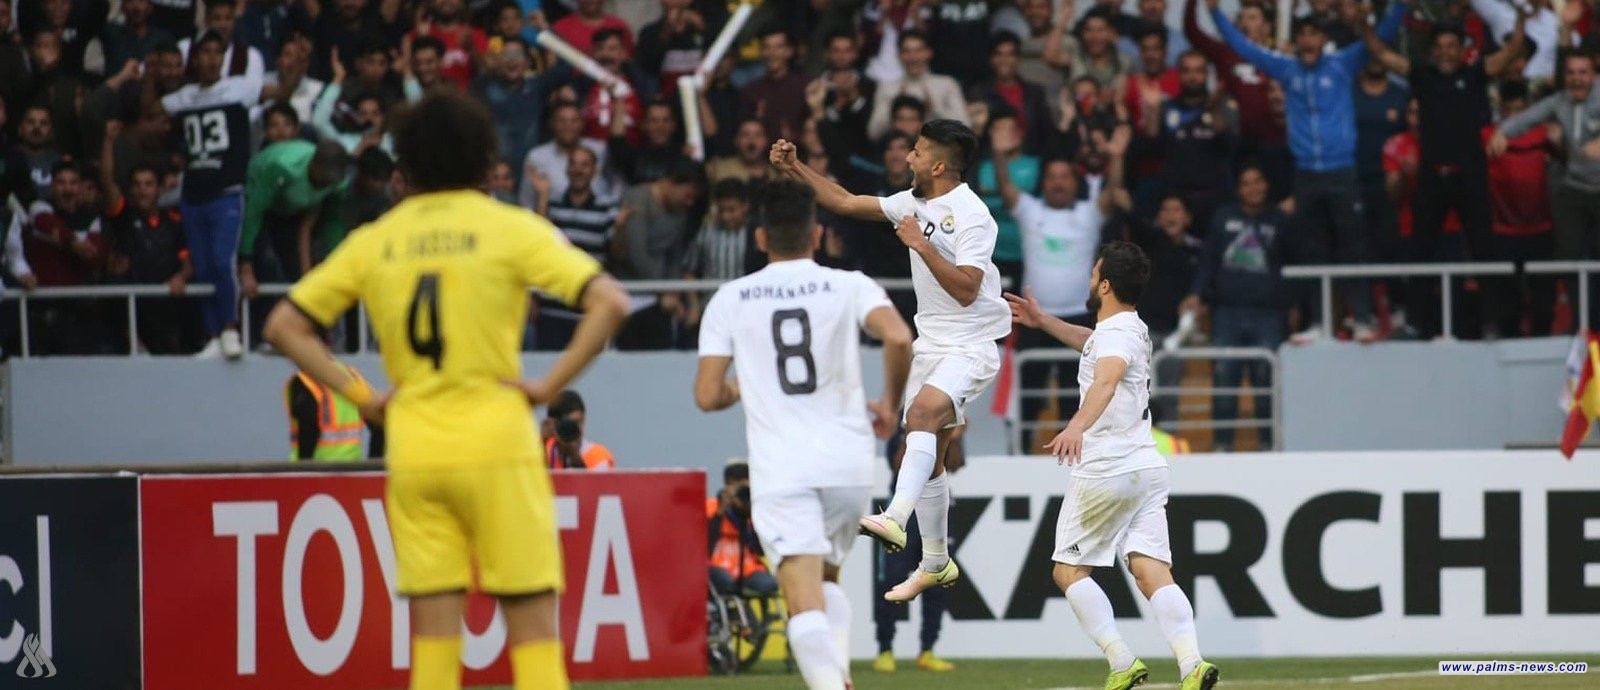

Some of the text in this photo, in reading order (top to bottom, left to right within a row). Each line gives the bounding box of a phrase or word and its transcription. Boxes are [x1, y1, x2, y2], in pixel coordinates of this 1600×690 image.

[407, 272, 443, 371] 4
[740, 282, 817, 300] MOHANAD
[772, 307, 817, 395] 8
[212, 493, 650, 677] TOYA
